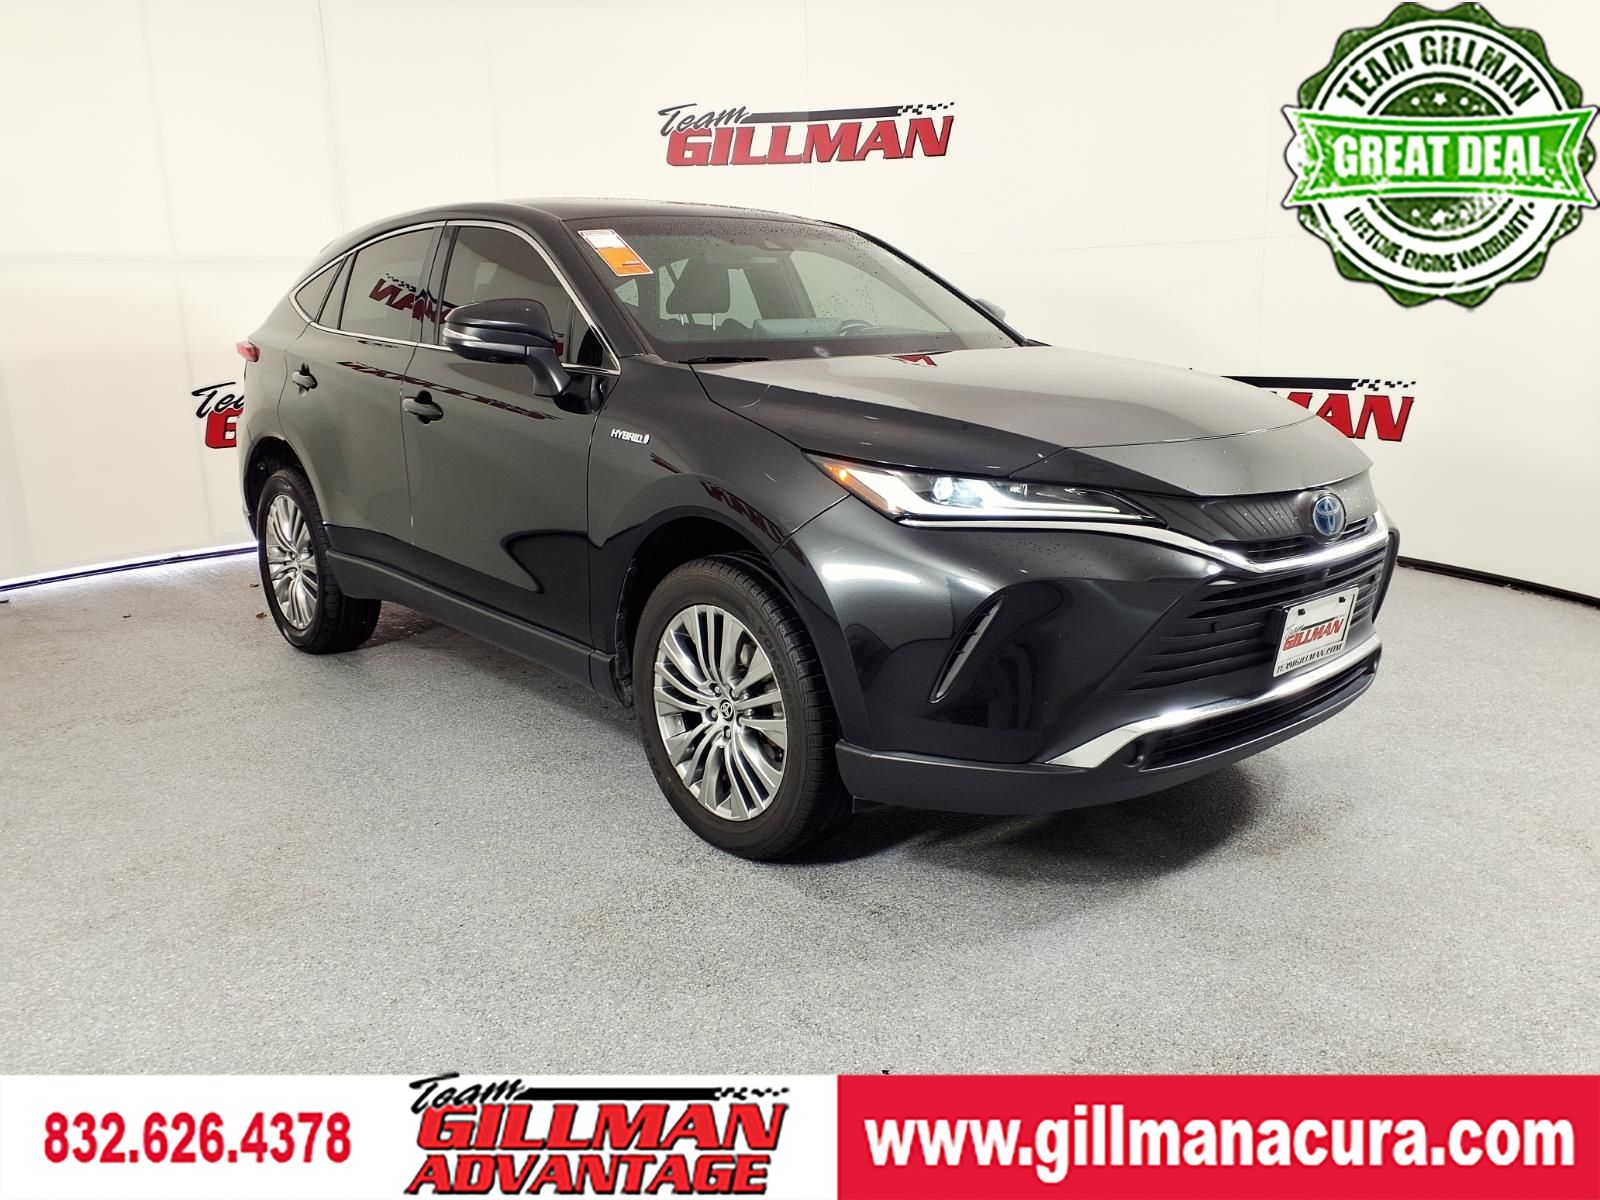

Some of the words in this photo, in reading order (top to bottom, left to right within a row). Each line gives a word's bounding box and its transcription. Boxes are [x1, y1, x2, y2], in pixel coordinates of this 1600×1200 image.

[657, 103, 752, 137] Team
[666, 115, 954, 167] GILLMAN
[191, 381, 244, 419] Te
[610, 428, 644, 444] HYBRID
[1282, 618, 1344, 652] GILLMAN
